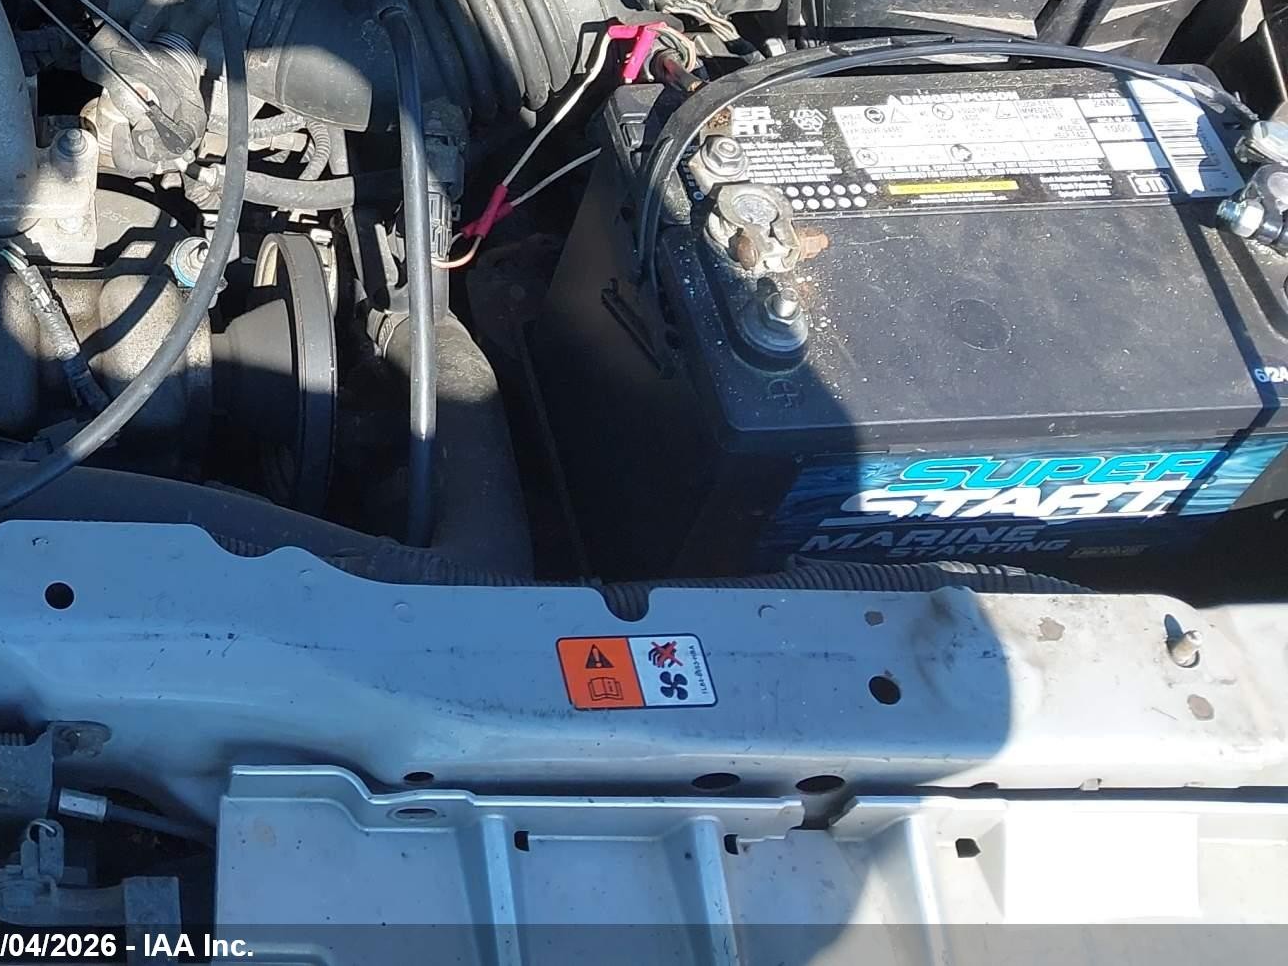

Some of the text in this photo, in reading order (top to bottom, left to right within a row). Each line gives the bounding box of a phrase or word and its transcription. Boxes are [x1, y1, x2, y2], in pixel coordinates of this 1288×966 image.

[886, 449, 1230, 491] SUPER
[840, 481, 1190, 518] START
[799, 524, 1048, 552] MARINE
[885, 539, 1071, 558] STARTING
